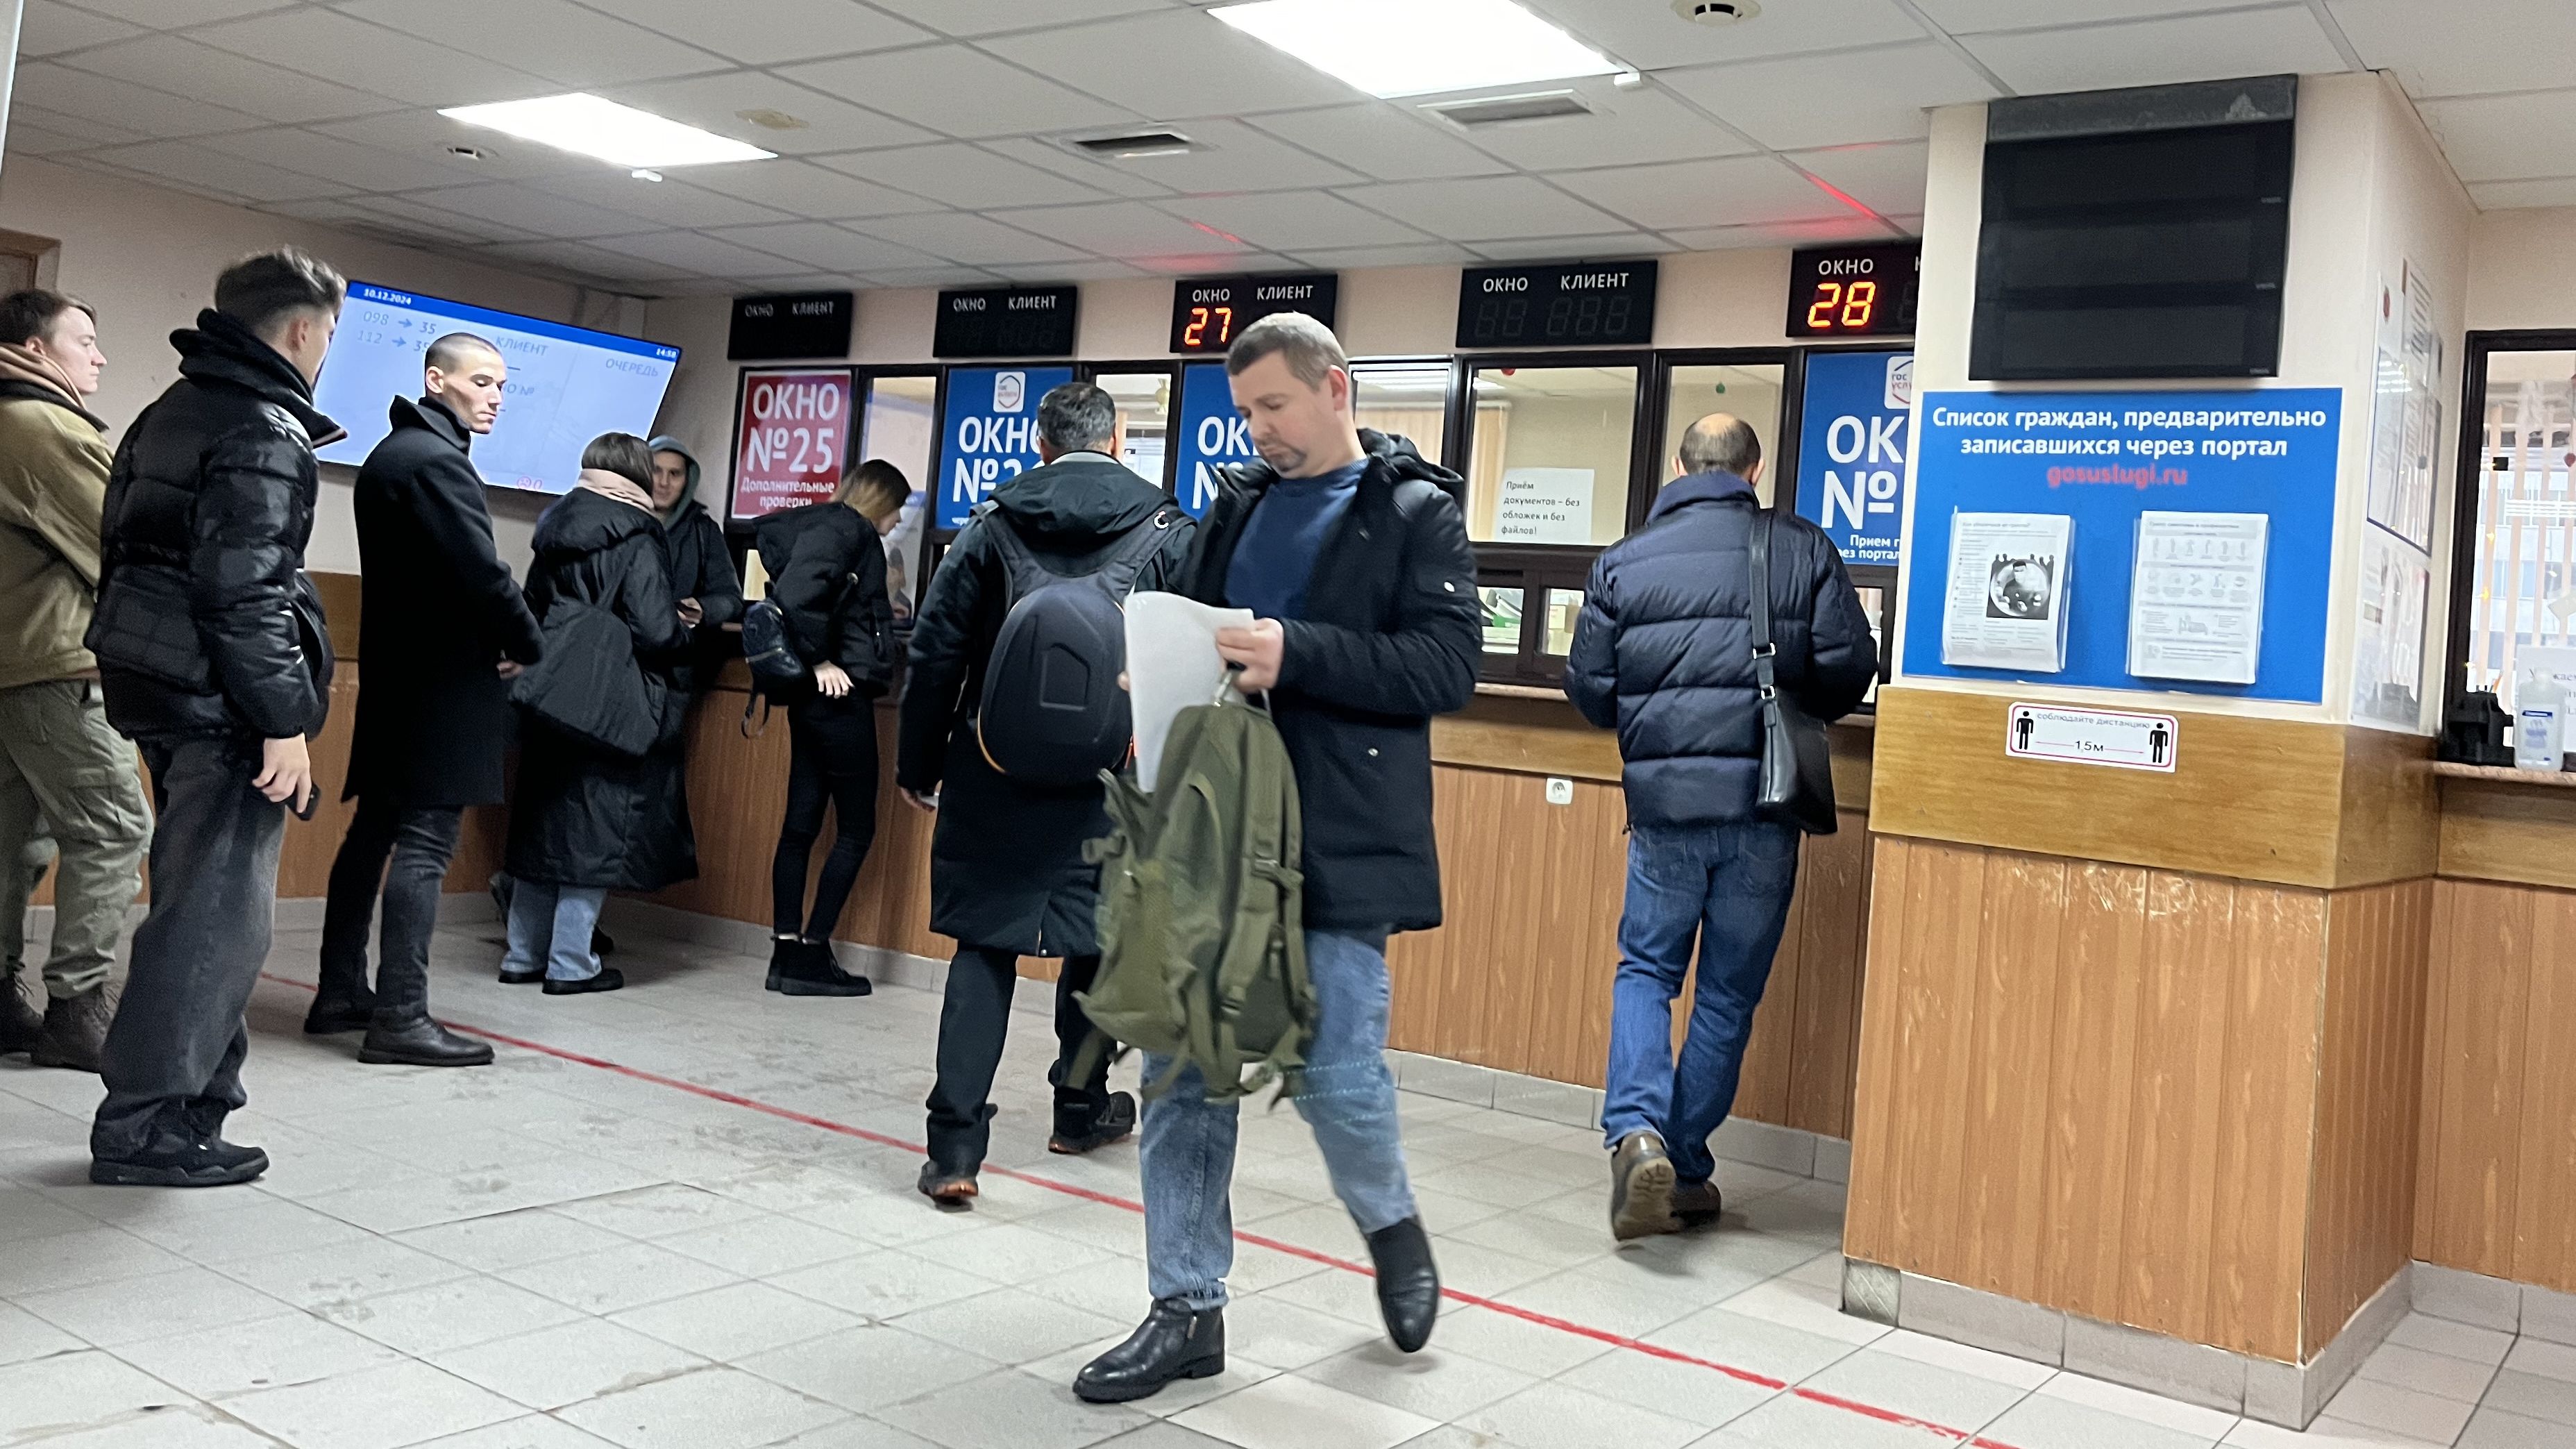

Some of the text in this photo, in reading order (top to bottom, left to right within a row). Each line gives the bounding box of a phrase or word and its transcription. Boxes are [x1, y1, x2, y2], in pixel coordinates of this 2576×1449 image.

[1818, 258, 1874, 275] ОКНО
[1483, 273, 1630, 292] ОКНО КЛИЕНТ
[952, 295, 1057, 312] ОКНО КЛИЕНТ
[1192, 285, 1313, 303] ОКНО КЛИЕНТ
[744, 301, 834, 317] ОКНО КЛИЕНТ
[1808, 281, 1876, 328] 28
[362, 310, 437, 335] 098 35
[1184, 307, 1231, 346] 27
[495, 336, 548, 356] КЛИЕНТ
[605, 358, 659, 377] ОЧЕРЕДЬ
[752, 383, 840, 421] ОКНО
[1933, 407, 2326, 431] Список граждан, предварительно
[1197, 416, 1260, 456] ОК
[1826, 415, 1905, 464] ОК
[747, 427, 834, 474] №25
[1960, 438, 2287, 460] записавшихся через портал
[740, 476, 835, 494] Дополнительные
[1506, 481, 1534, 490] Приём
[2047, 463, 2188, 490] gosuslugi.ru
[759, 495, 813, 510] проверки
[1504, 497, 1556, 505] документов
[1565, 497, 1580, 506] без
[1502, 510, 1540, 519] обложек
[1550, 512, 1565, 521] без
[1850, 534, 1890, 548] Прием
